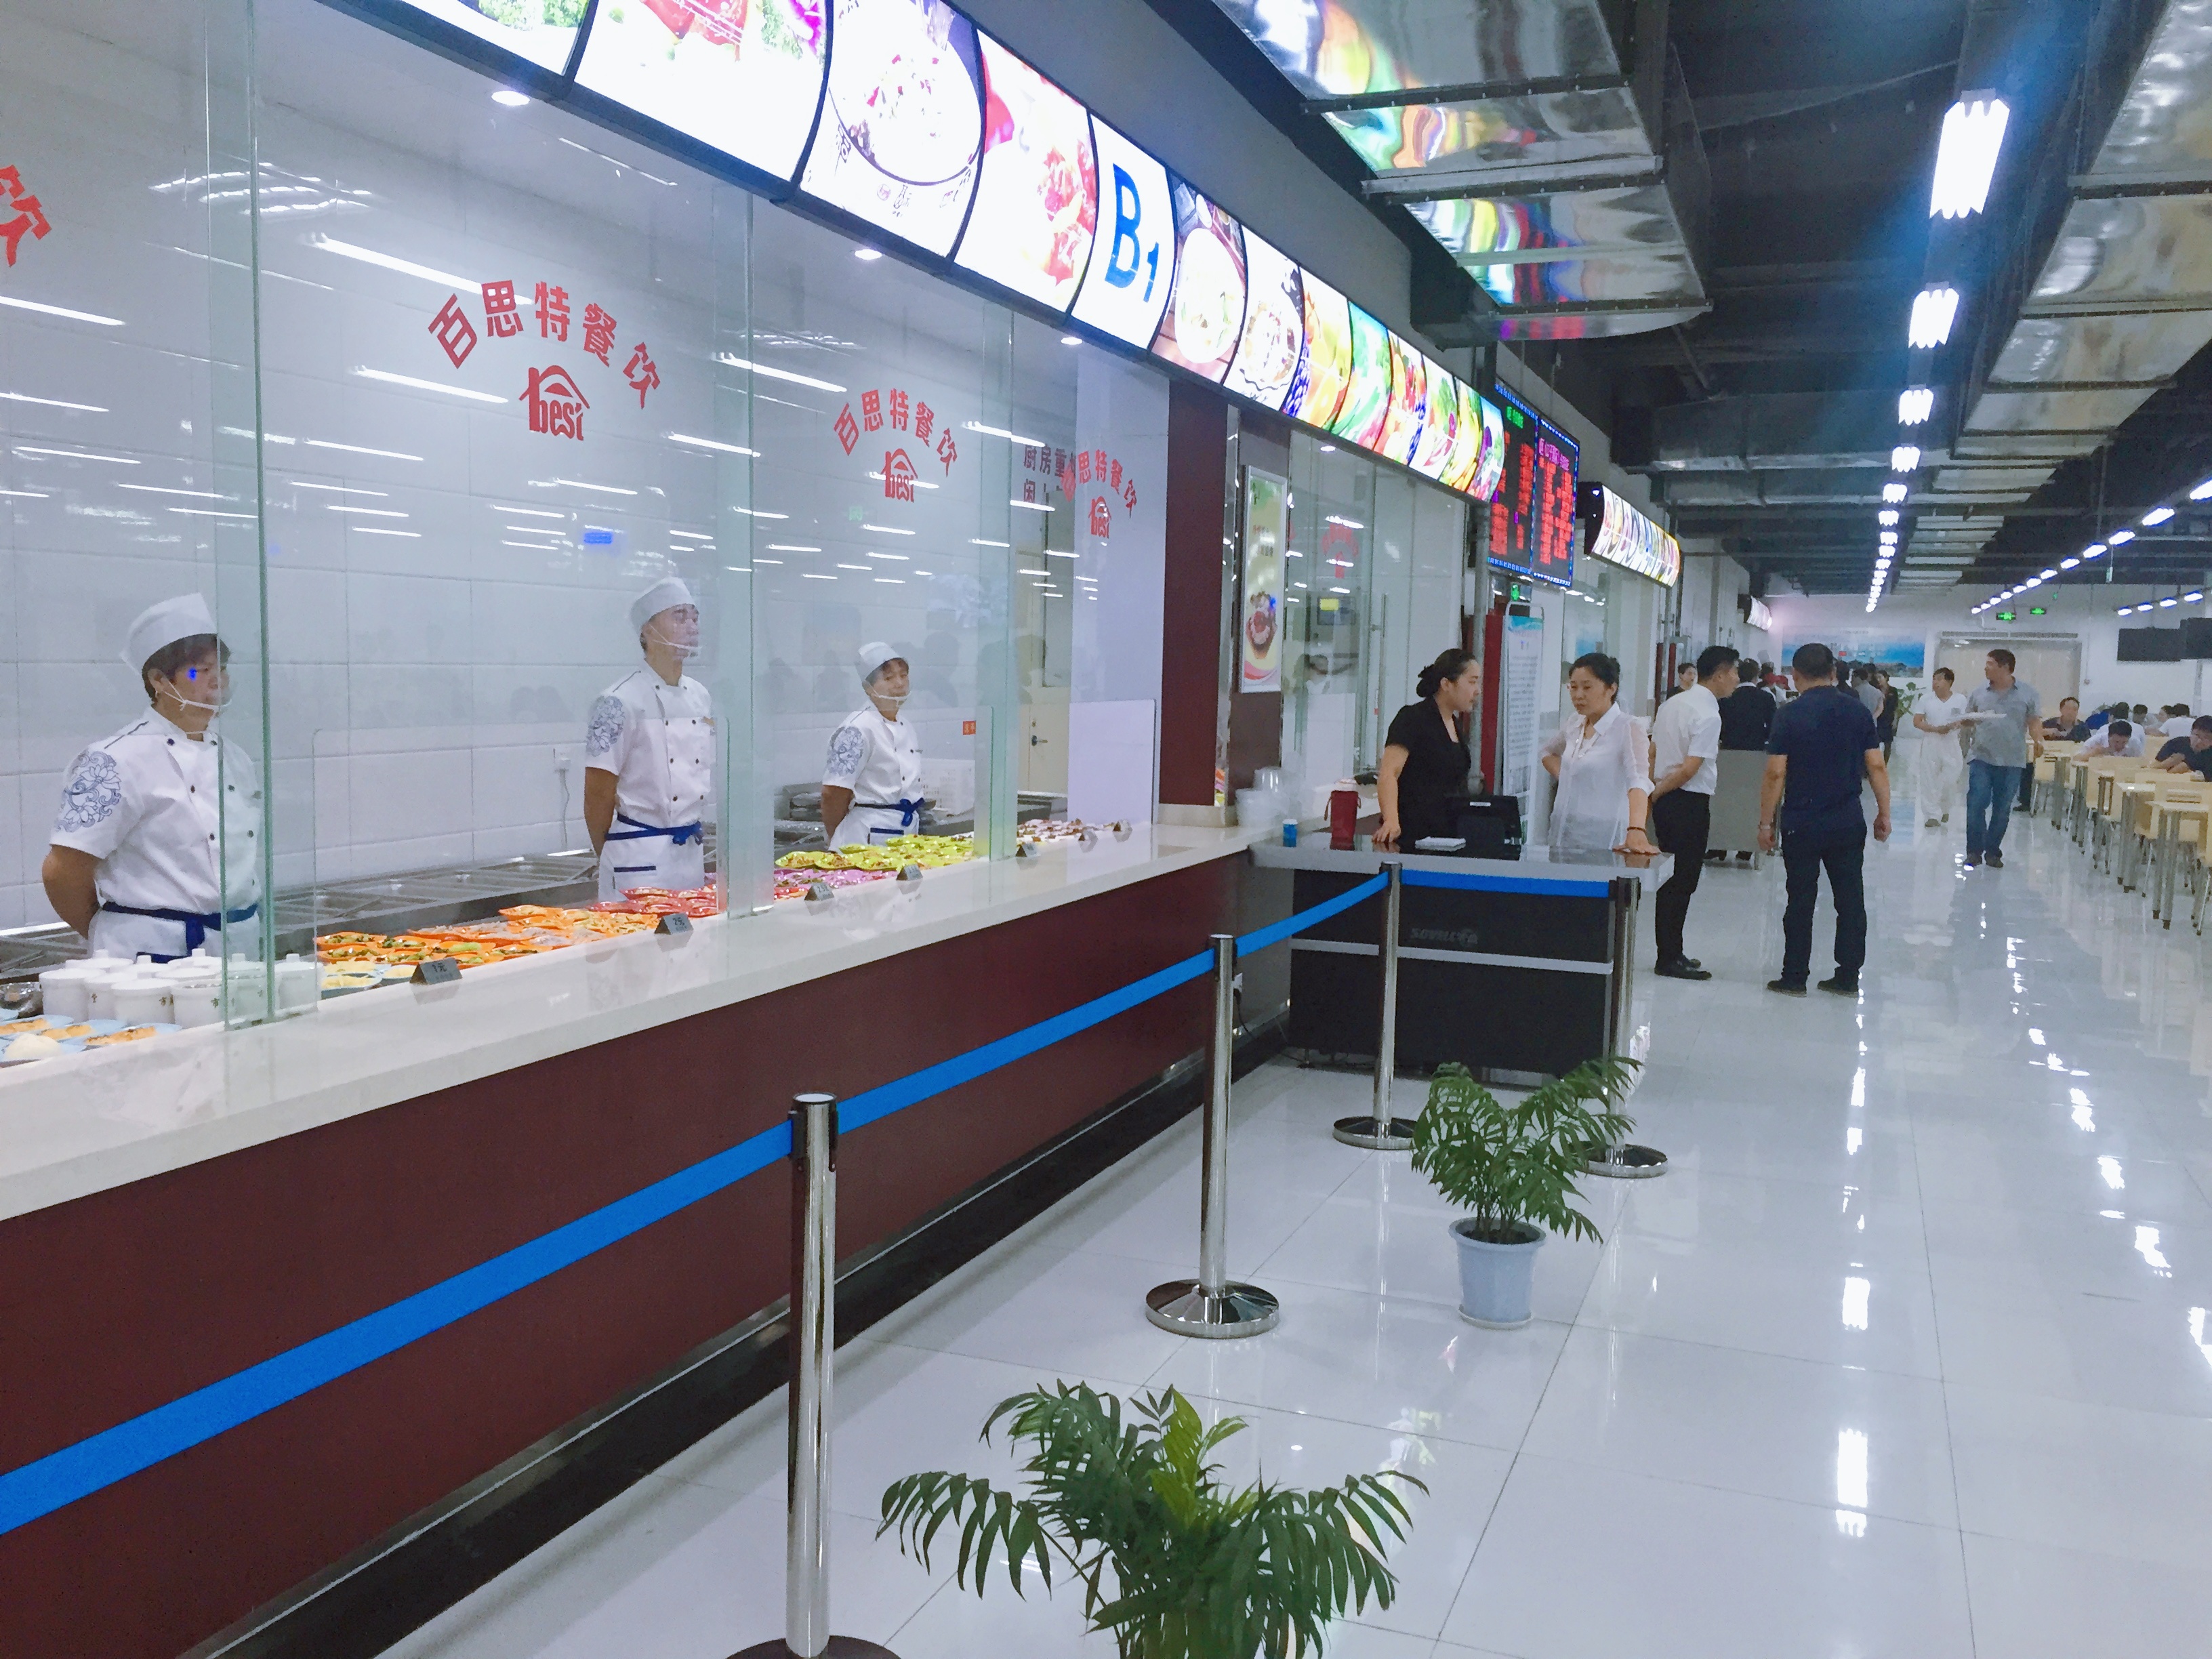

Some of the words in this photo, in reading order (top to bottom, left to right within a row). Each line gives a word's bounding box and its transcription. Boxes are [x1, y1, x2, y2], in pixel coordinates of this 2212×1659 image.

[1104, 163, 1160, 304] B1
[428, 279, 661, 409] 百思特餐饮
[834, 388, 958, 477] 百思特餐饮
